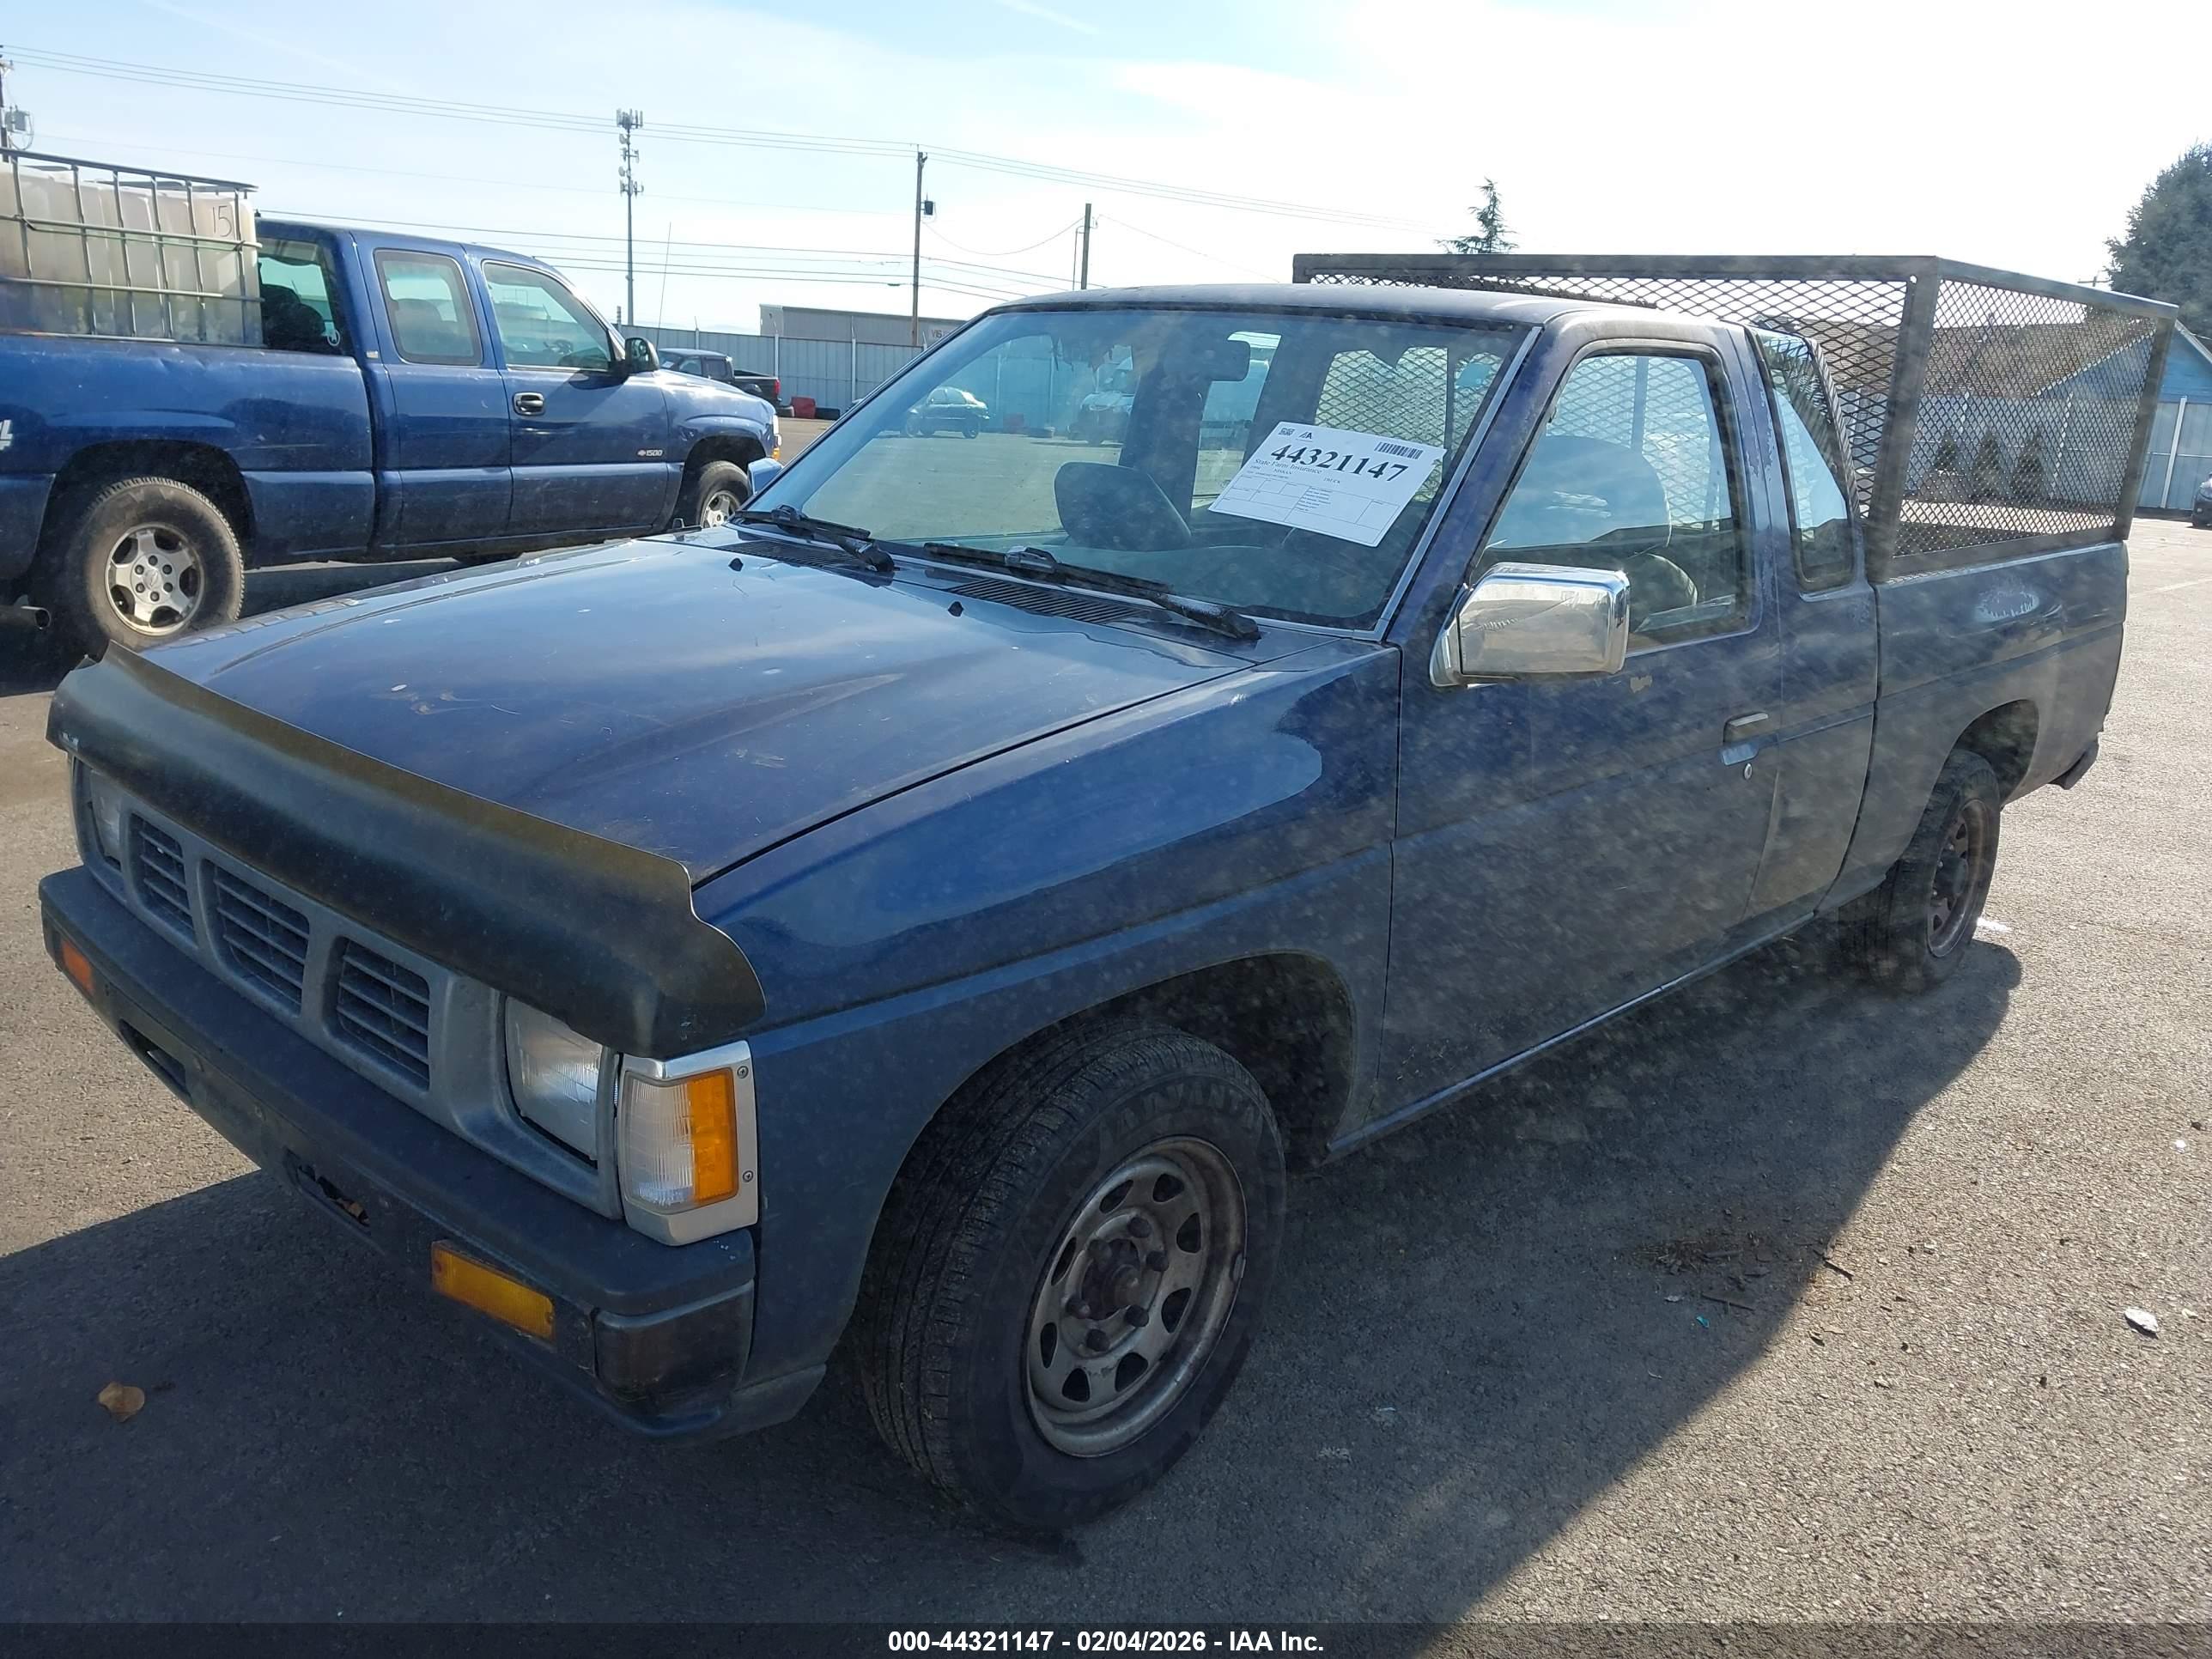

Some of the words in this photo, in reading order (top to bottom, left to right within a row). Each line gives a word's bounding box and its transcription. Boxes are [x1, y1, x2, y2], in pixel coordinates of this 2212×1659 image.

[213, 205, 233, 237] 15
[1271, 444, 1408, 481] 44321147
[1290, 464, 1322, 474] Insurance
